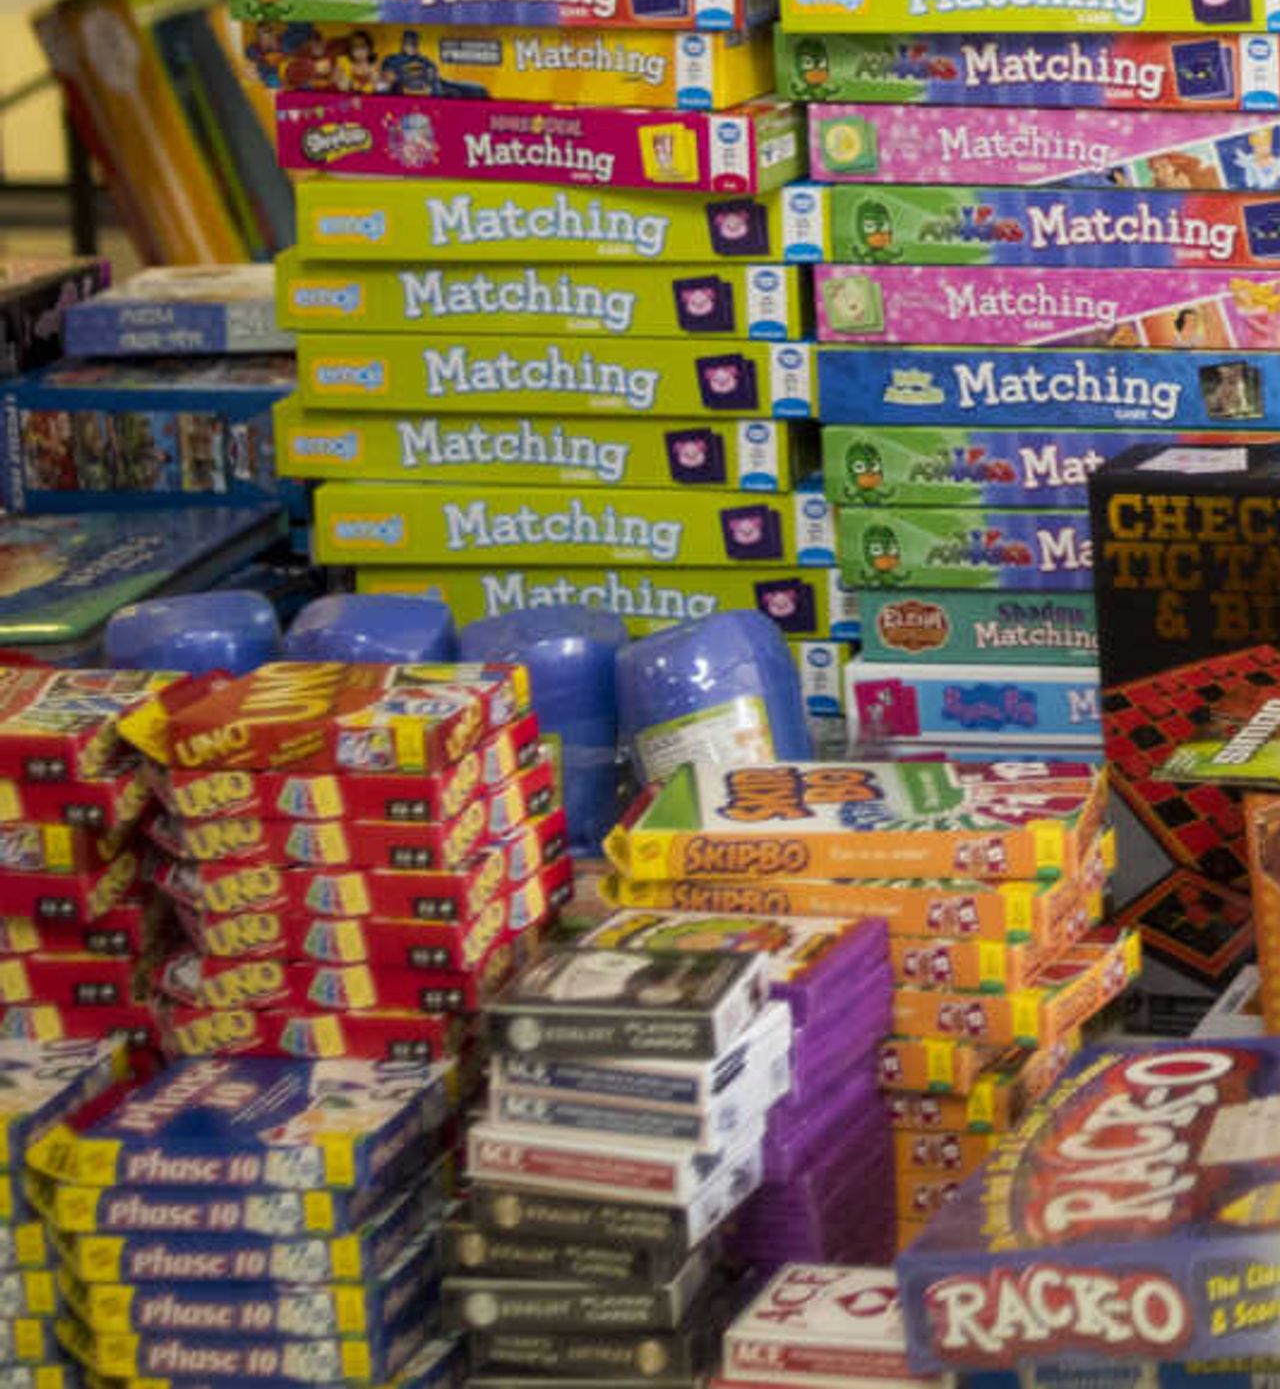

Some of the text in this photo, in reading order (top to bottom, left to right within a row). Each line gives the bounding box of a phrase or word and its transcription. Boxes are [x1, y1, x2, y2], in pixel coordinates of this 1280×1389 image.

[515, 35, 667, 85] Matching
[961, 43, 1166, 104] Matching
[463, 133, 615, 182] Matching
[937, 128, 1117, 175] Matching
[428, 195, 669, 257] Matching
[1026, 204, 1238, 263] Matching
[400, 268, 637, 332] Matching
[944, 283, 1120, 329] Matching
[422, 347, 659, 409] Matching
[953, 359, 1183, 420] Matching
[398, 419, 630, 482] Matching
[441, 500, 682, 560] Matching
[1104, 540, 1205, 589] TIC
[1154, 591, 1191, 641] &
[175, 721, 250, 768] UNO
[174, 771, 255, 818] UNO
[185, 818, 263, 860] UNO
[204, 864, 282, 913] UNO
[204, 913, 281, 957] UNO
[201, 960, 284, 1007] UNO
[175, 1009, 257, 1056] UNO
[1044, 1050, 1235, 1233] RACK-O
[126, 1148, 260, 1184] Phase 10
[107, 1196, 240, 1229] Phase 10
[132, 1244, 267, 1277] Phase 10
[140, 1294, 273, 1329] Phase 10
[935, 1266, 1185, 1351] RACK-O
[1206, 1274, 1241, 1301] The
[1210, 1309, 1228, 1335] &
[147, 1342, 280, 1376] Phase 10
